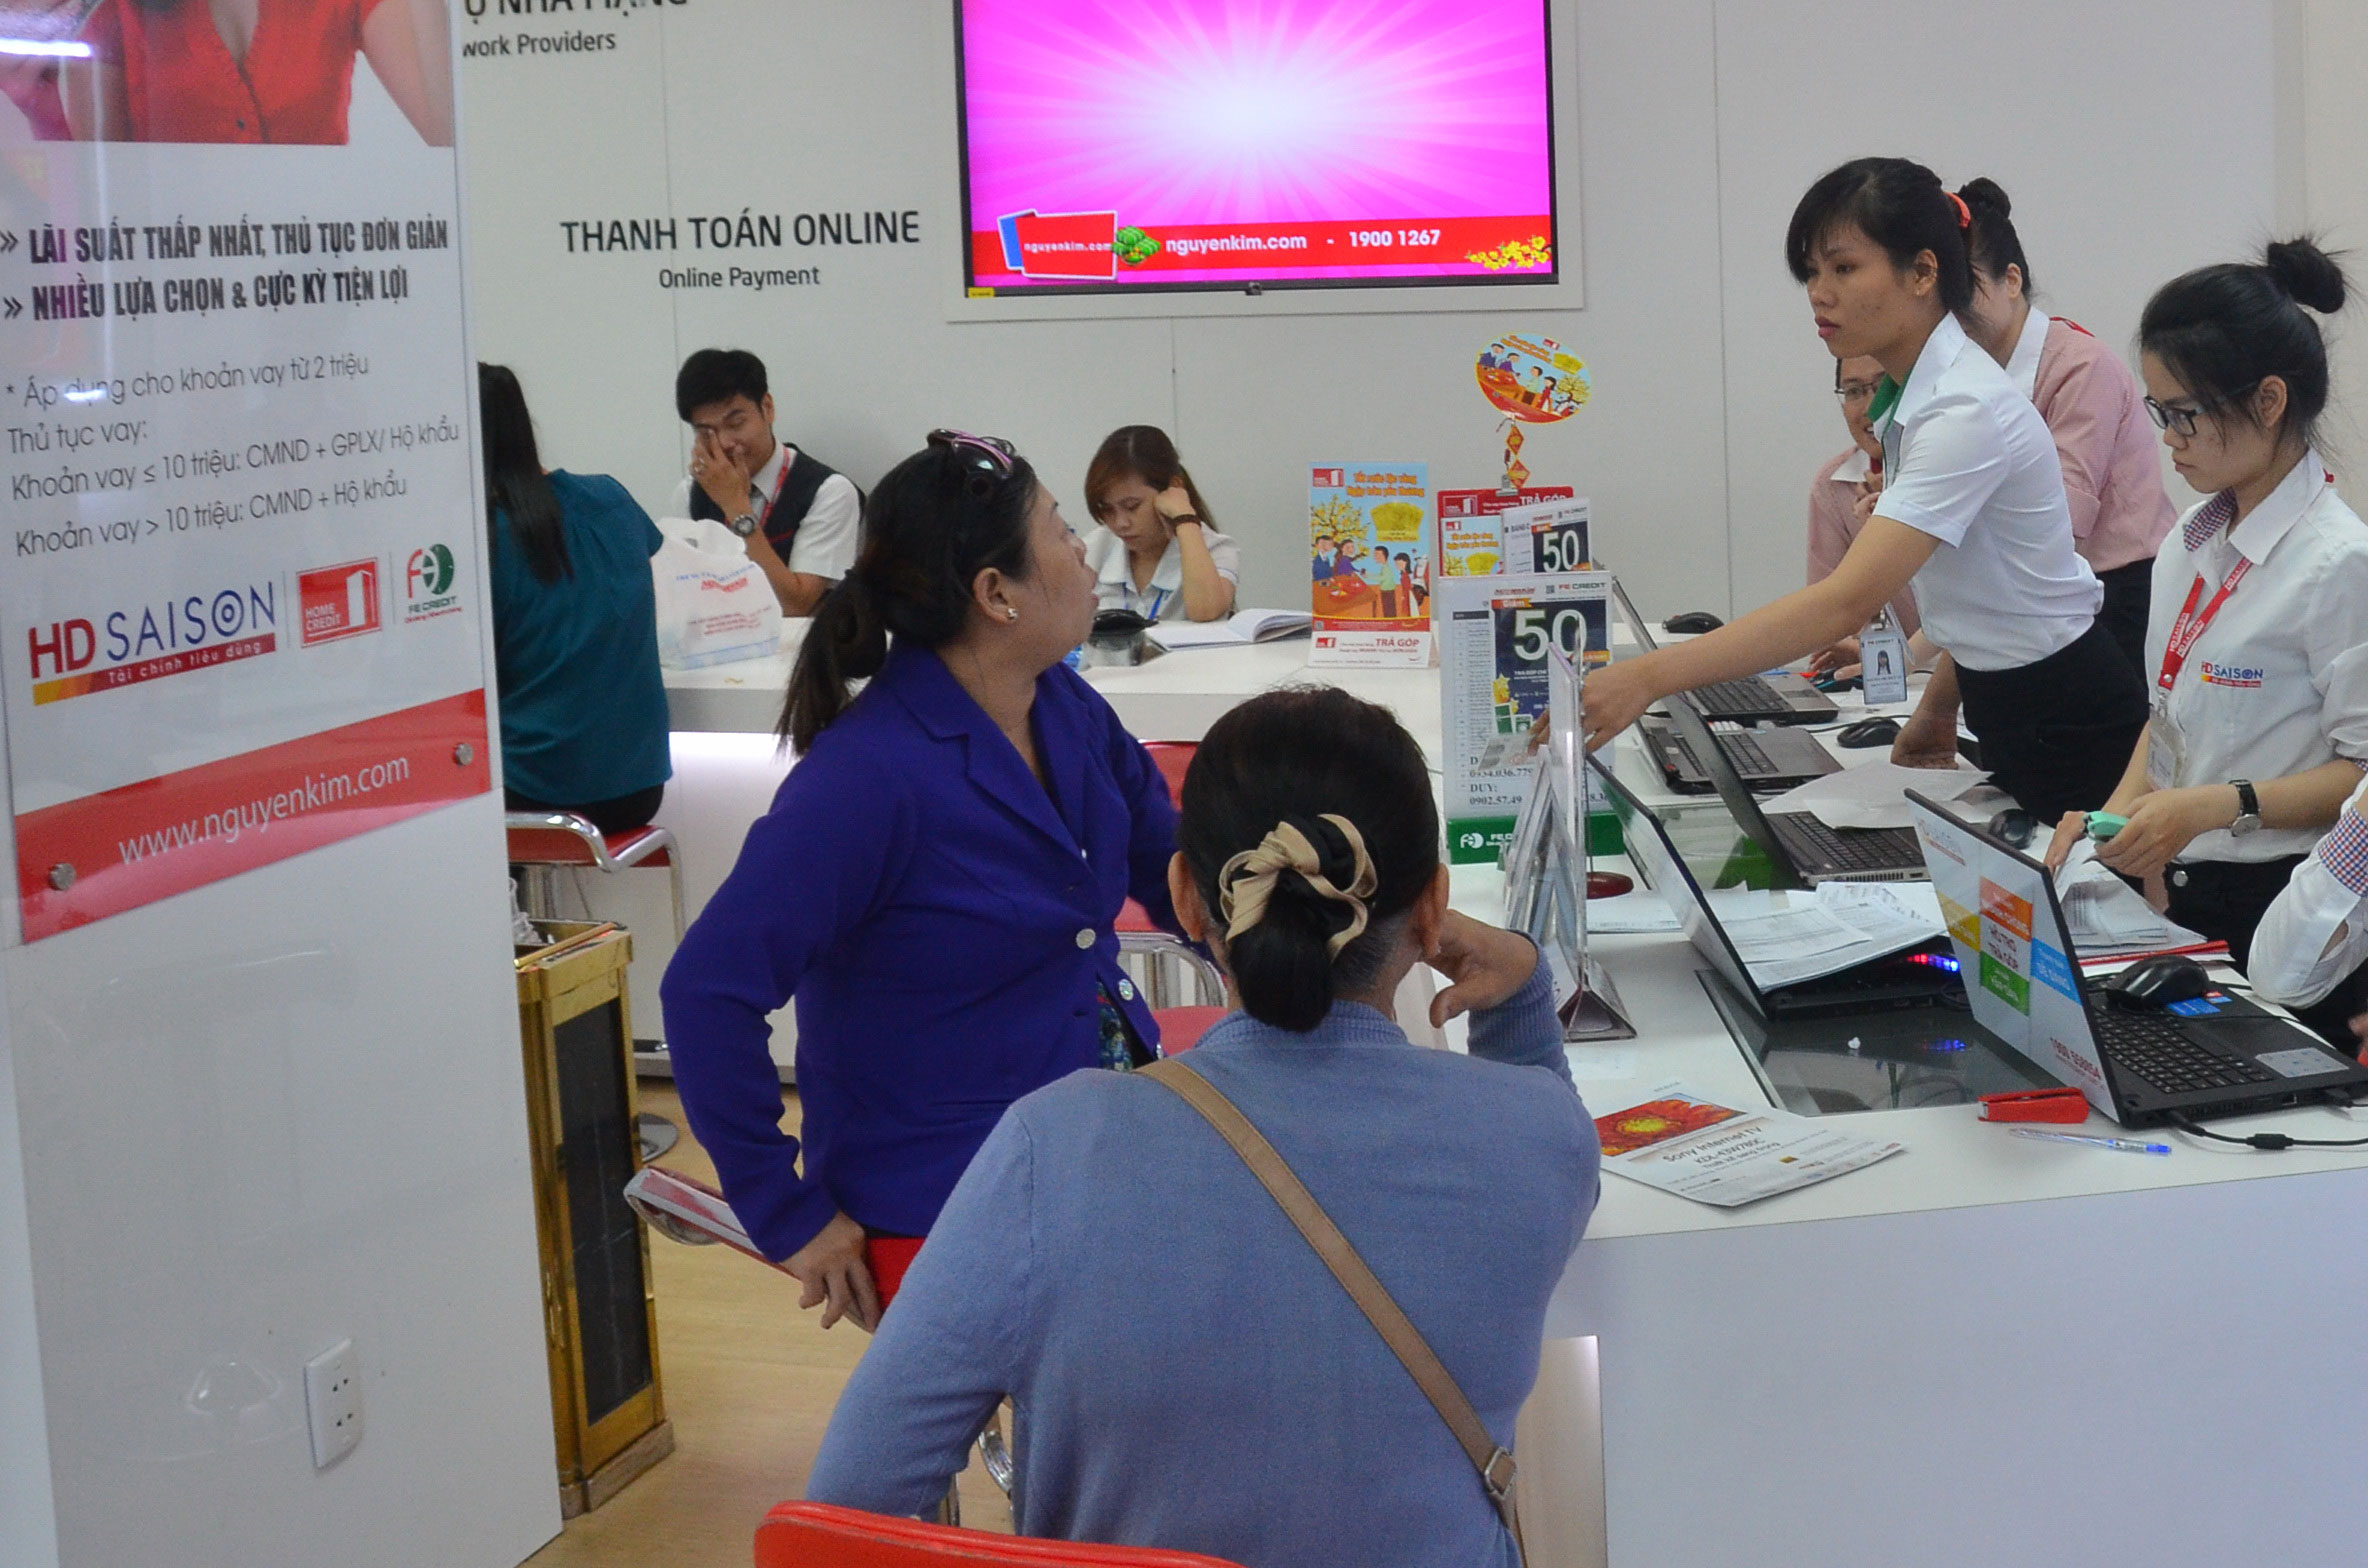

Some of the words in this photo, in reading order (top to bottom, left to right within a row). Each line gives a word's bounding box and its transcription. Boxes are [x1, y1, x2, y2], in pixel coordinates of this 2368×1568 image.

[518, 30, 616, 54] Providers
[29, 223, 67, 263] LÃI
[74, 216, 136, 262] SUẤT
[144, 214, 201, 259] THẤP
[272, 215, 311, 254] THỦ
[318, 222, 355, 258] TỤC
[362, 217, 400, 251] ĐƠN
[406, 212, 448, 250] GIẢN
[560, 219, 677, 252] THANH
[688, 207, 782, 248] TOÁN
[793, 210, 920, 246] ONLINE
[1024, 241, 1112, 254] nguyenkim.com
[1165, 234, 1307, 256] nguyenkim.com
[1349, 230, 1392, 247] 1900
[1398, 229, 1440, 246] 1267
[32, 272, 104, 320] NHIỀU
[114, 276, 157, 322] LỰA
[164, 278, 224, 317] CHỌN
[232, 282, 247, 308] &
[254, 270, 296, 312] CỰC
[303, 268, 326, 304] KỲ
[334, 266, 374, 306] TIỆN
[380, 264, 408, 304] LỢI
[658, 266, 723, 290] Online
[729, 264, 820, 291] Payment
[24, 376, 58, 411] Áp
[132, 371, 174, 397] cho
[180, 361, 244, 392] khoản
[250, 364, 284, 387] vay
[291, 357, 309, 380] từ
[314, 356, 325, 378] 2
[330, 353, 368, 380] triệu
[8, 422, 49, 453] Thủ
[56, 424, 94, 452] tục
[100, 420, 148, 445] vay:
[12, 466, 89, 500] Khoản
[95, 466, 136, 490] vay
[163, 454, 186, 479] 10
[191, 450, 240, 478] triệu:
[246, 439, 309, 468] CMND
[331, 429, 385, 456] GPLX/
[391, 424, 414, 450] Hộ
[418, 414, 459, 444] khẩu
[16, 520, 92, 556] Khoản
[99, 520, 140, 544] vay
[166, 506, 188, 532] 10
[194, 501, 243, 530] triệu:
[250, 488, 312, 518] CMND
[334, 480, 359, 507] Hộ
[364, 469, 406, 499] khẩu
[1543, 530, 1580, 572] 50
[1572, 582, 1606, 590] CREDIT
[306, 602, 336, 618] HOME
[306, 614, 342, 632] CREDIT
[29, 618, 96, 679] HD
[107, 581, 275, 662] SAISON
[1514, 609, 1587, 660] 50
[108, 671, 132, 684] Tài
[140, 658, 182, 678] chính
[226, 640, 262, 658] dùng
[2214, 665, 2263, 678] SAISON
[1470, 784, 1498, 793] DUY:
[118, 754, 410, 865] www.nguyenkim.com
[1662, 1148, 1698, 1162] Sony
[1697, 1132, 1746, 1151] Internet
